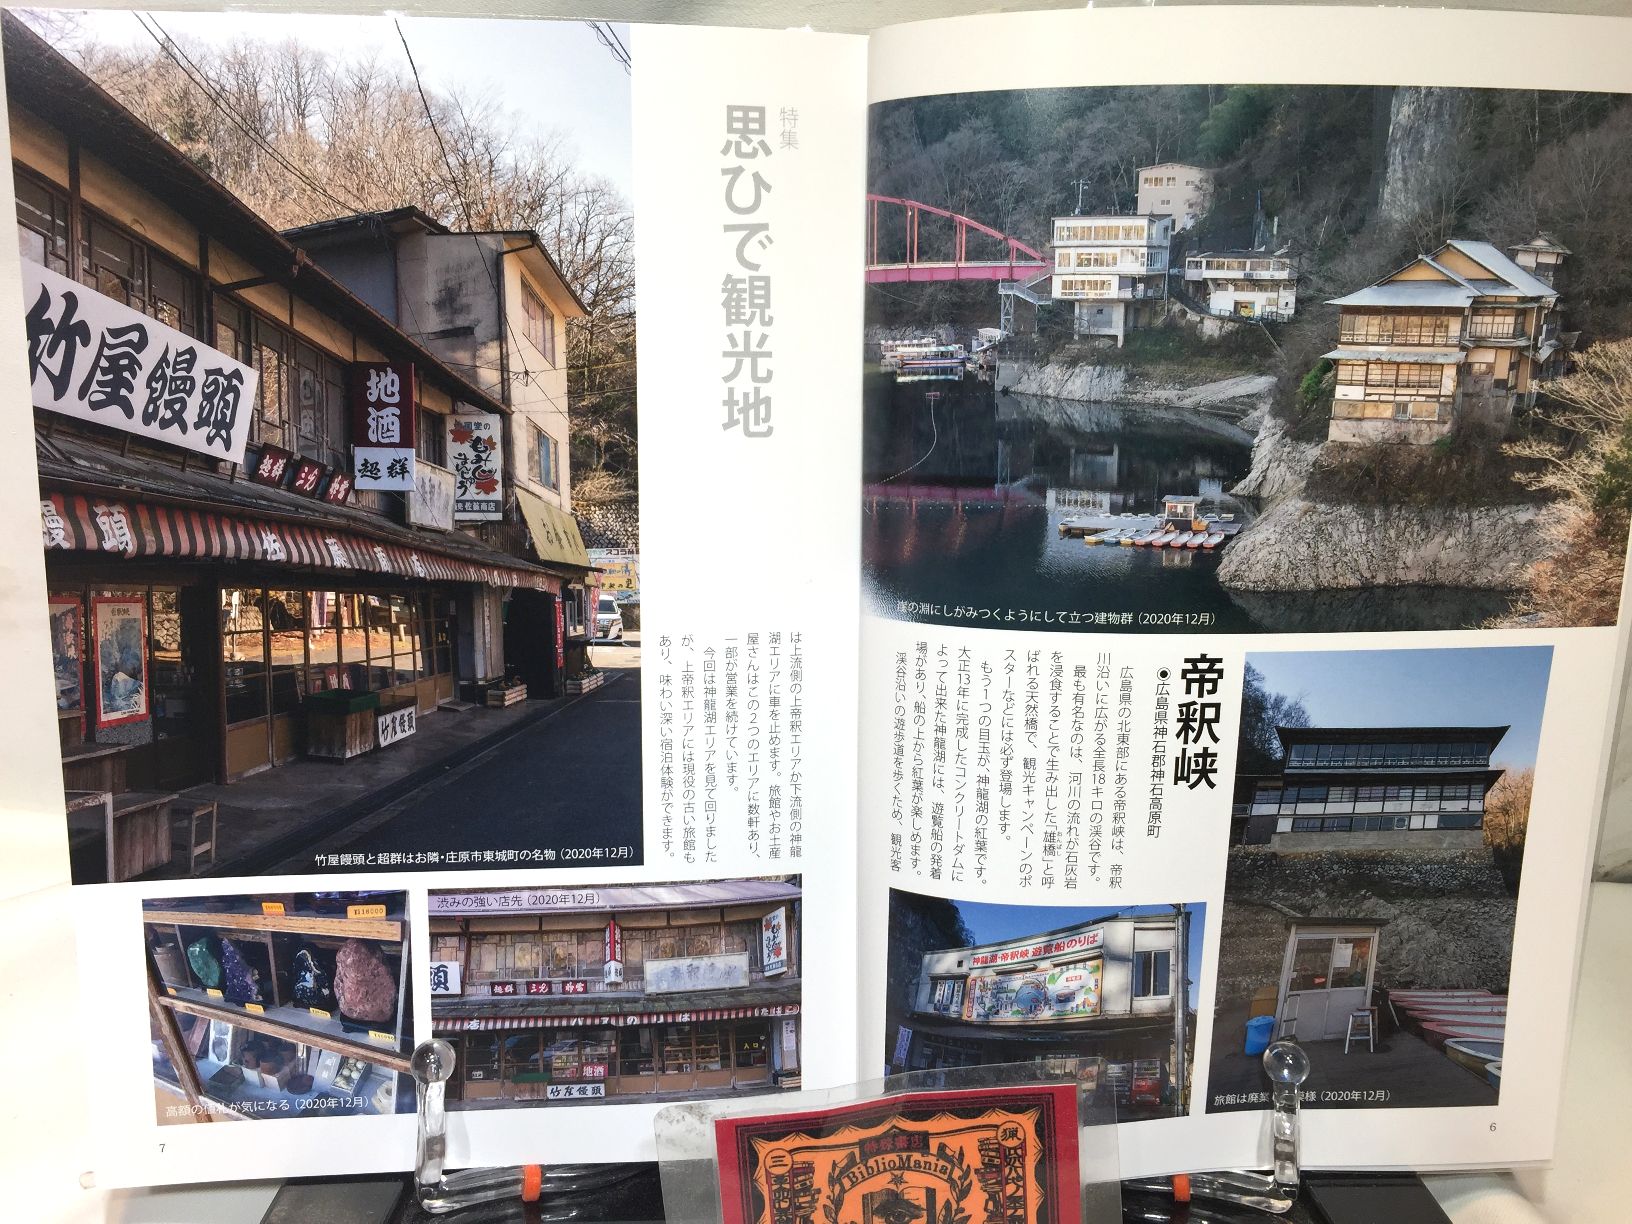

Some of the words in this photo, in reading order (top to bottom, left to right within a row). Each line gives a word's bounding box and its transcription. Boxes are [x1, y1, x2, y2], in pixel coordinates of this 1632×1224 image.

[779, 105, 800, 152] 特集
[720, 104, 774, 439] 思ひで観光地
[358, 456, 411, 482] 超群
[366, 367, 401, 444] 地酒
[659, 635, 675, 859] あり、味わい深い宿泊体験ができます。
[681, 634, 696, 864] が、上帝釈エリアには現役の古い旅館も
[703, 646, 718, 863] 今回は神龍湖エリアを見て回りました
[725, 637, 739, 793] 一部が営業を続けています。
[768, 632, 782, 860] 湖エリアに車を止めます。旅館やお土産
[789, 632, 803, 858] は上流側の上帝釈エリアか下流側の神龍
[890, 651, 907, 872] 渓谷沿いの遊歩道を歩くため、観光客
[909, 641, 928, 877] 場があり、船の上から紅葉が楽しめます。
[929, 643, 949, 881] よって出来た神龍湖には、遊覧船の発着
[951, 645, 971, 882] 大正13年に完成したコンクリートダムに
[998, 649, 1017, 841] スターなどには必ず登場します。
[1018, 650, 1041, 888] ばれる天然橋で、観光キャンペーンのポ
[1041, 650, 1064, 890] を浸食することで生み出した「雄橋」と呼
[1064, 664, 1087, 890] 最も有名なのは、河川の流れが石灰岩
[1087, 652, 1112, 882] 川沿いに広がる全長18キロの渓谷です。
[1109, 665, 1134, 889] 広島県の北東部にある帝釈峡は、帝釈
[1173, 653, 1225, 790] 帝釈峡
[1032, 932, 1099, 957] 遊覧船のりば
[159, 1143, 166, 1153] 7
[550, 1085, 603, 1096] 竹屋饅頭
[582, 1065, 604, 1077] 地酒
[768, 1154, 789, 1169] 三
[845, 1153, 949, 1184] BiblioMania
[1489, 1122, 1497, 1132] 6
